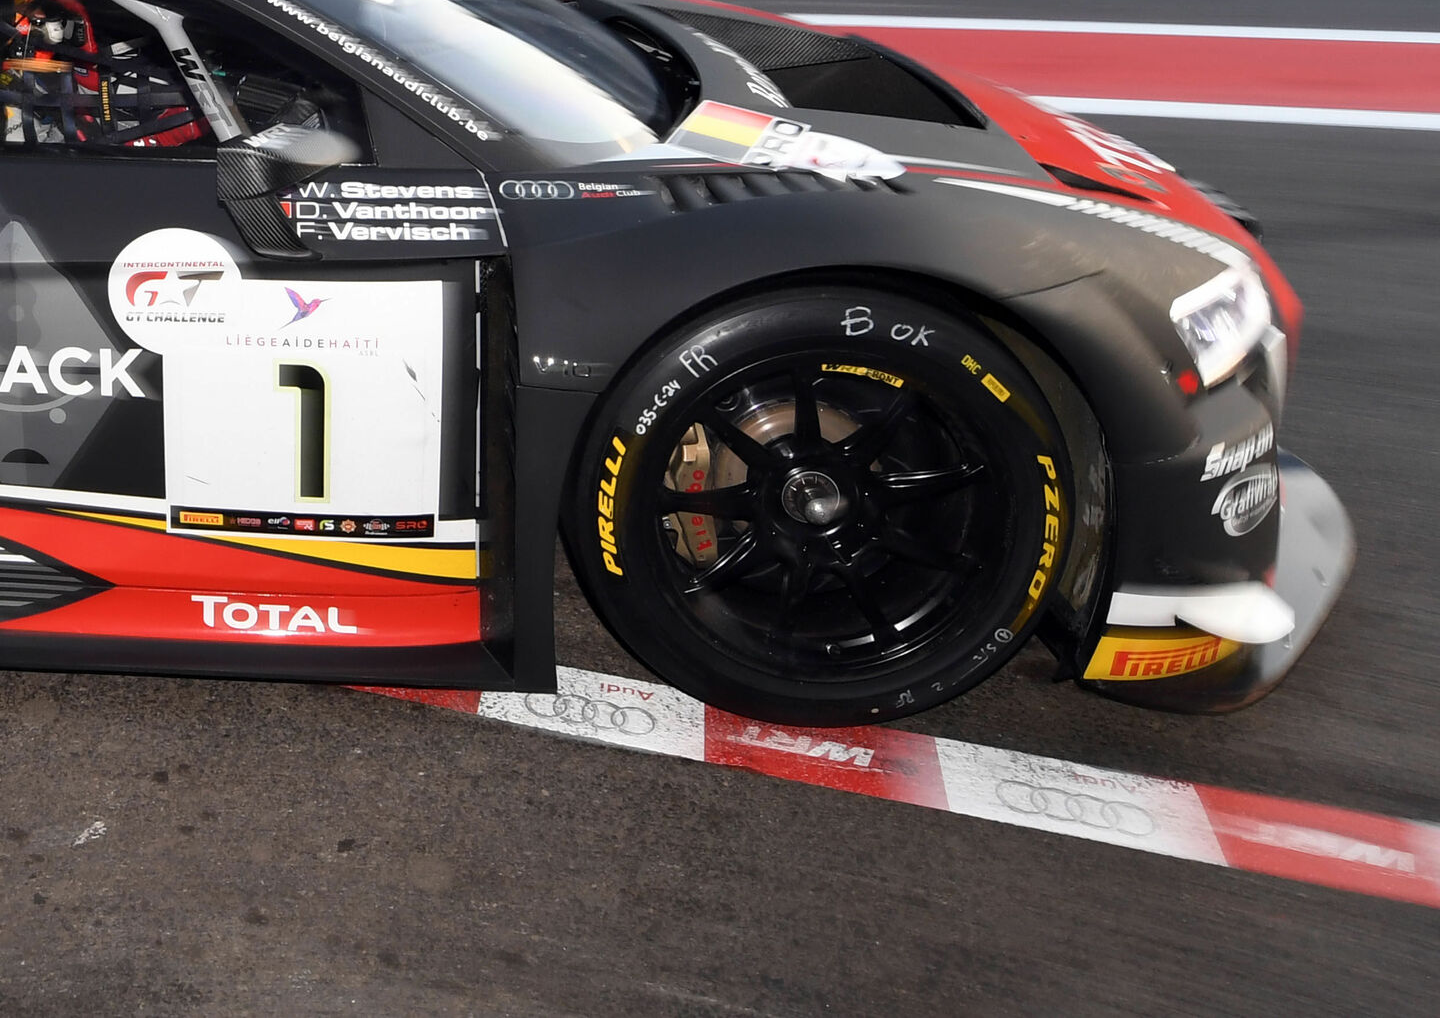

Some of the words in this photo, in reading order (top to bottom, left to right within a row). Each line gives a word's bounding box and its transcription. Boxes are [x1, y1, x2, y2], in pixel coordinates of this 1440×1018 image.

[299, 182, 335, 198] W.
[340, 181, 474, 199] Stevens
[578, 183, 619, 192] Belgian
[296, 202, 327, 219] D.
[332, 201, 487, 220] Vanthoor
[296, 222, 323, 240] F.
[328, 222, 470, 241] Vervisch
[126, 311, 144, 322] GT
[146, 311, 226, 323] CHALLENGE
[679, 344, 718, 380] FR
[961, 354, 982, 375] DHC
[865, 368, 901, 386] FRONT
[278, 363, 326, 498] 1
[596, 436, 627, 576] PIRELLI
[190, 594, 358, 634] TOTAL
[1109, 635, 1222, 677] PIRELLI
[599, 681, 654, 701] Audi
